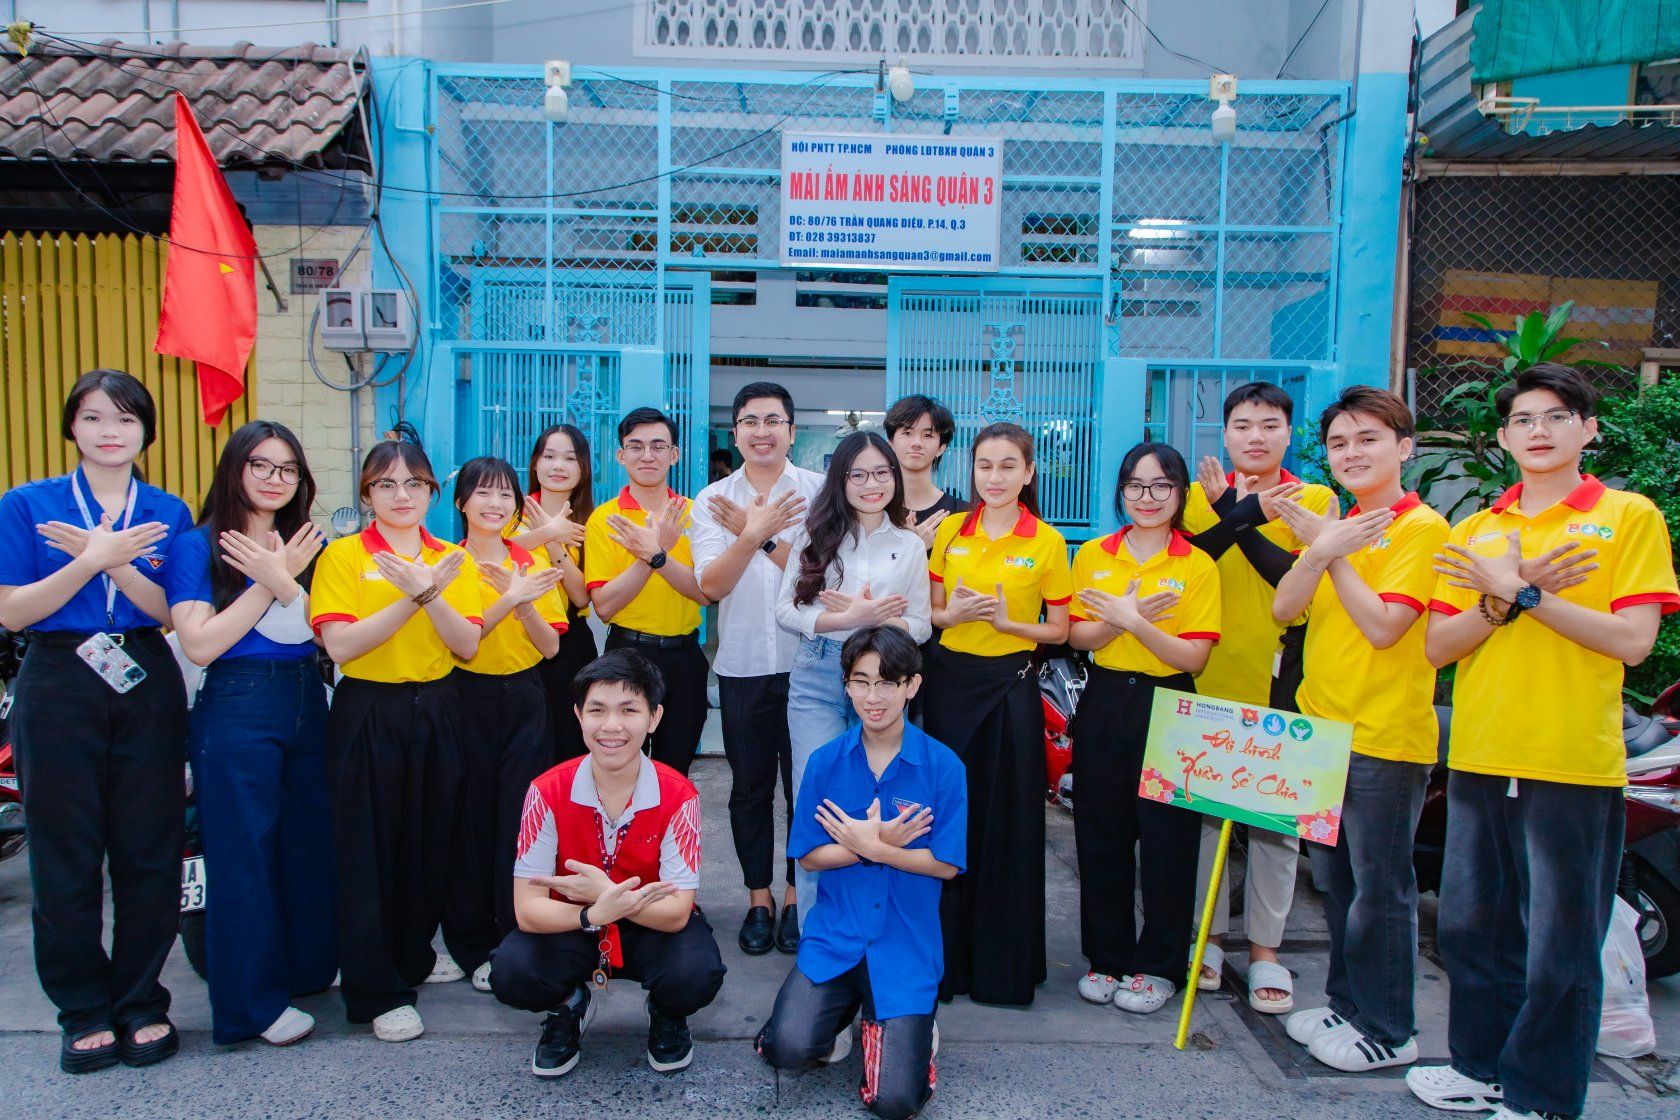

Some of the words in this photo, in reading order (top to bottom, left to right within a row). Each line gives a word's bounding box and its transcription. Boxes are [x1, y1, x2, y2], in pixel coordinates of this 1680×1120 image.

[791, 141, 809, 156] HỘI
[811, 143, 836, 154] PNTT
[838, 143, 872, 154] TP.HCM
[886, 143, 919, 156] PHÒNG
[921, 145, 957, 157] LĐTBXH
[960, 145, 986, 159] QUẬN
[988, 147, 995, 157] 3
[790, 168, 820, 201] MÁI
[824, 163, 848, 202] ẤM
[852, 169, 885, 202] ÁNH
[889, 170, 932, 203] SÁNG
[936, 171, 979, 210] QUẬN
[983, 176, 994, 206] 3
[808, 215, 837, 228] 80/76
[867, 217, 899, 230] QUANG
[928, 219, 948, 231] P.14,
[950, 219, 966, 231] Q.3
[805, 232, 825, 243] 028
[827, 232, 876, 244] 39313837
[788, 247, 819, 258] Email:
[821, 248, 992, 263] maiamanhsangquan3@gmail.com
[298, 265, 334, 277] 80/78
[1176, 698, 1193, 715] H
